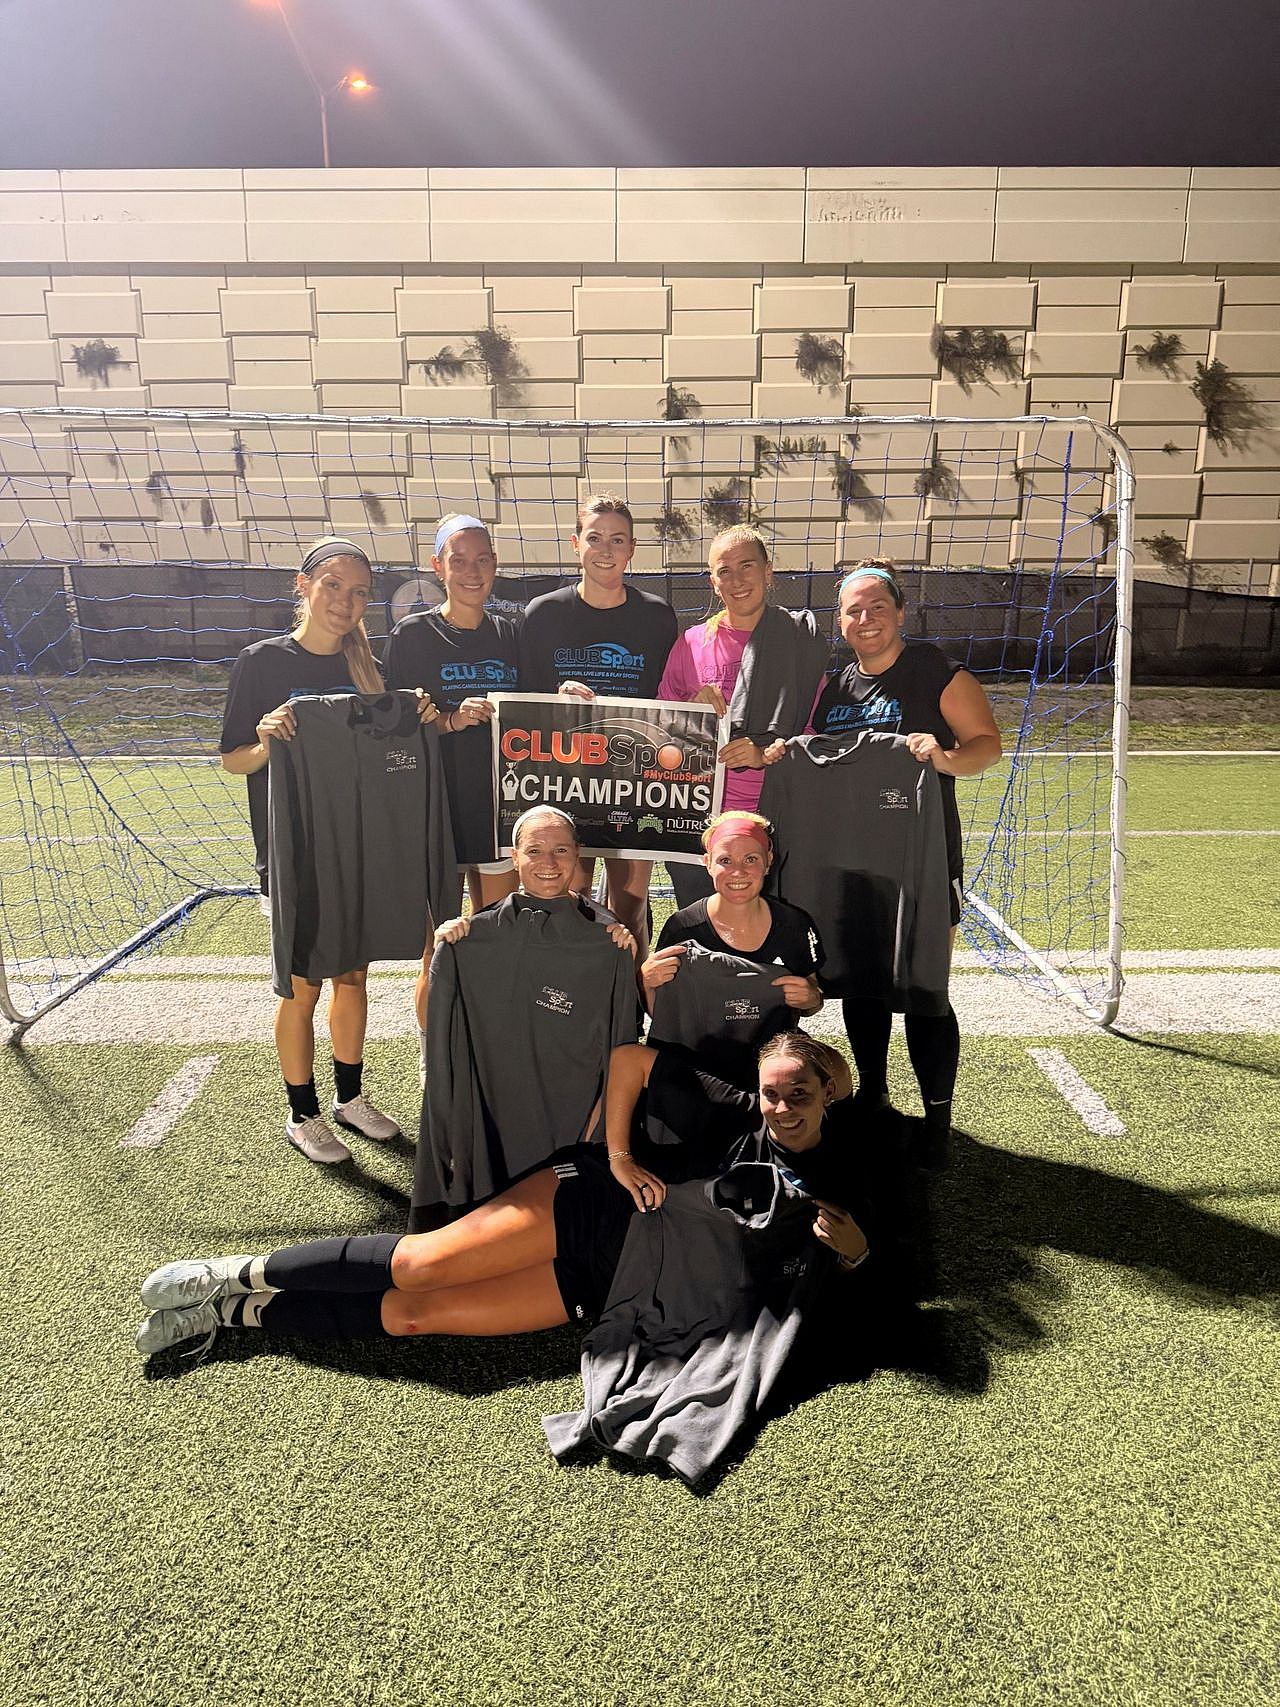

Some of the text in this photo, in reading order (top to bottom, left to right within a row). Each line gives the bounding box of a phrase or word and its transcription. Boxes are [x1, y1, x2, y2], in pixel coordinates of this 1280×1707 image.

[554, 647, 645, 668] CLUBSport
[501, 728, 714, 776] CLUBSport
[643, 769, 712, 784] #MyClubSport
[520, 774, 711, 811] CHAMPIONS
[535, 999, 571, 1016] CHAMPION
[725, 1013, 760, 1021] CHAMPION
